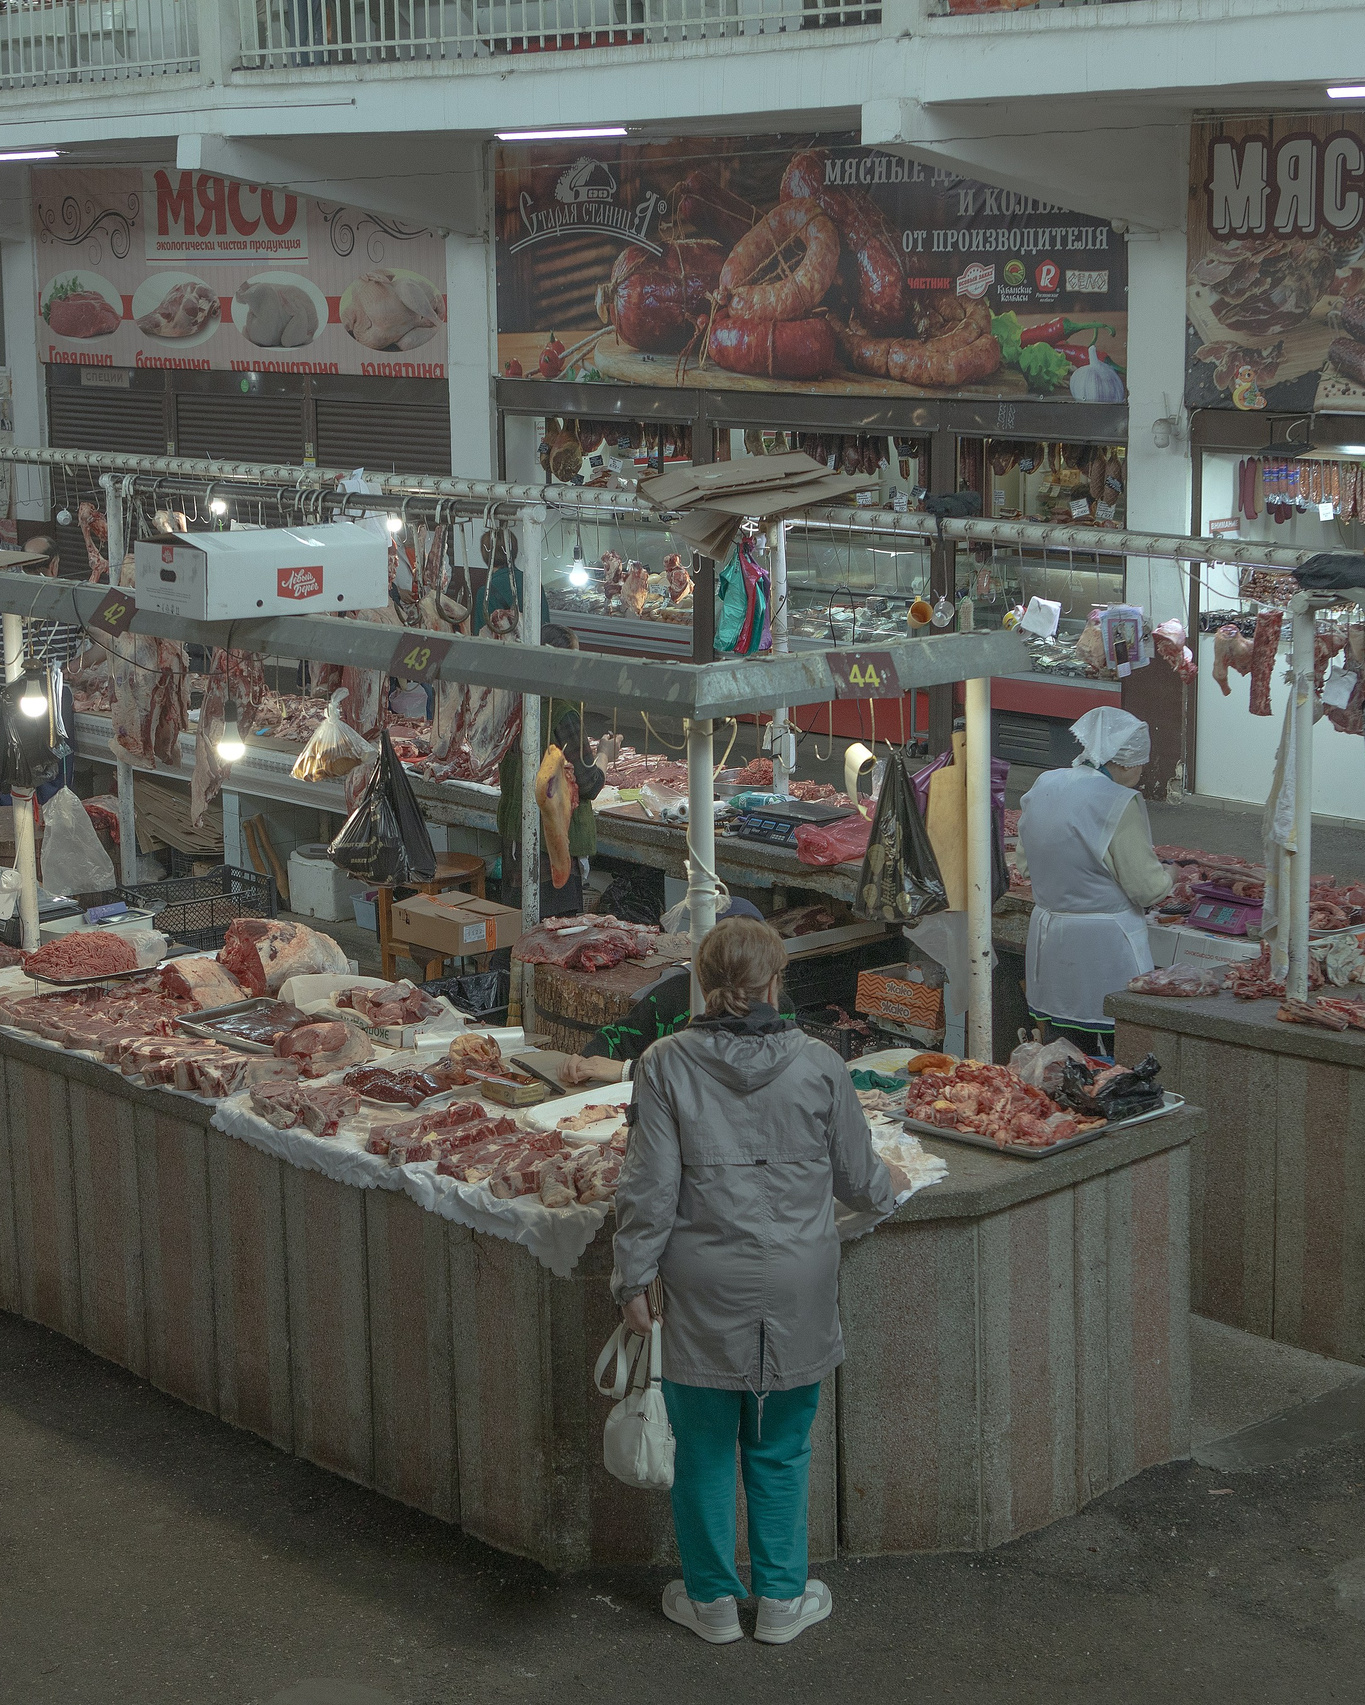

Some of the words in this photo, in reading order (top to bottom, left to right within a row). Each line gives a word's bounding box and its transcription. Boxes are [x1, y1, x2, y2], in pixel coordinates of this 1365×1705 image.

[153, 169, 298, 237] МЯСО
[957, 189, 976, 216] И
[156, 240, 215, 251] экологически
[217, 240, 248, 250] чистая
[249, 238, 301, 253] продукция
[902, 230, 927, 252] ОТ
[931, 226, 1109, 255] ПРОИЗВОДИТЕЛЯ
[85, 372, 123, 383] СПЕЦИИ
[1210, 519, 1239, 530] ВНИМАНИЕ
[103, 602, 126, 625] 42
[403, 646, 431, 671] 43
[849, 663, 881, 688] 44
